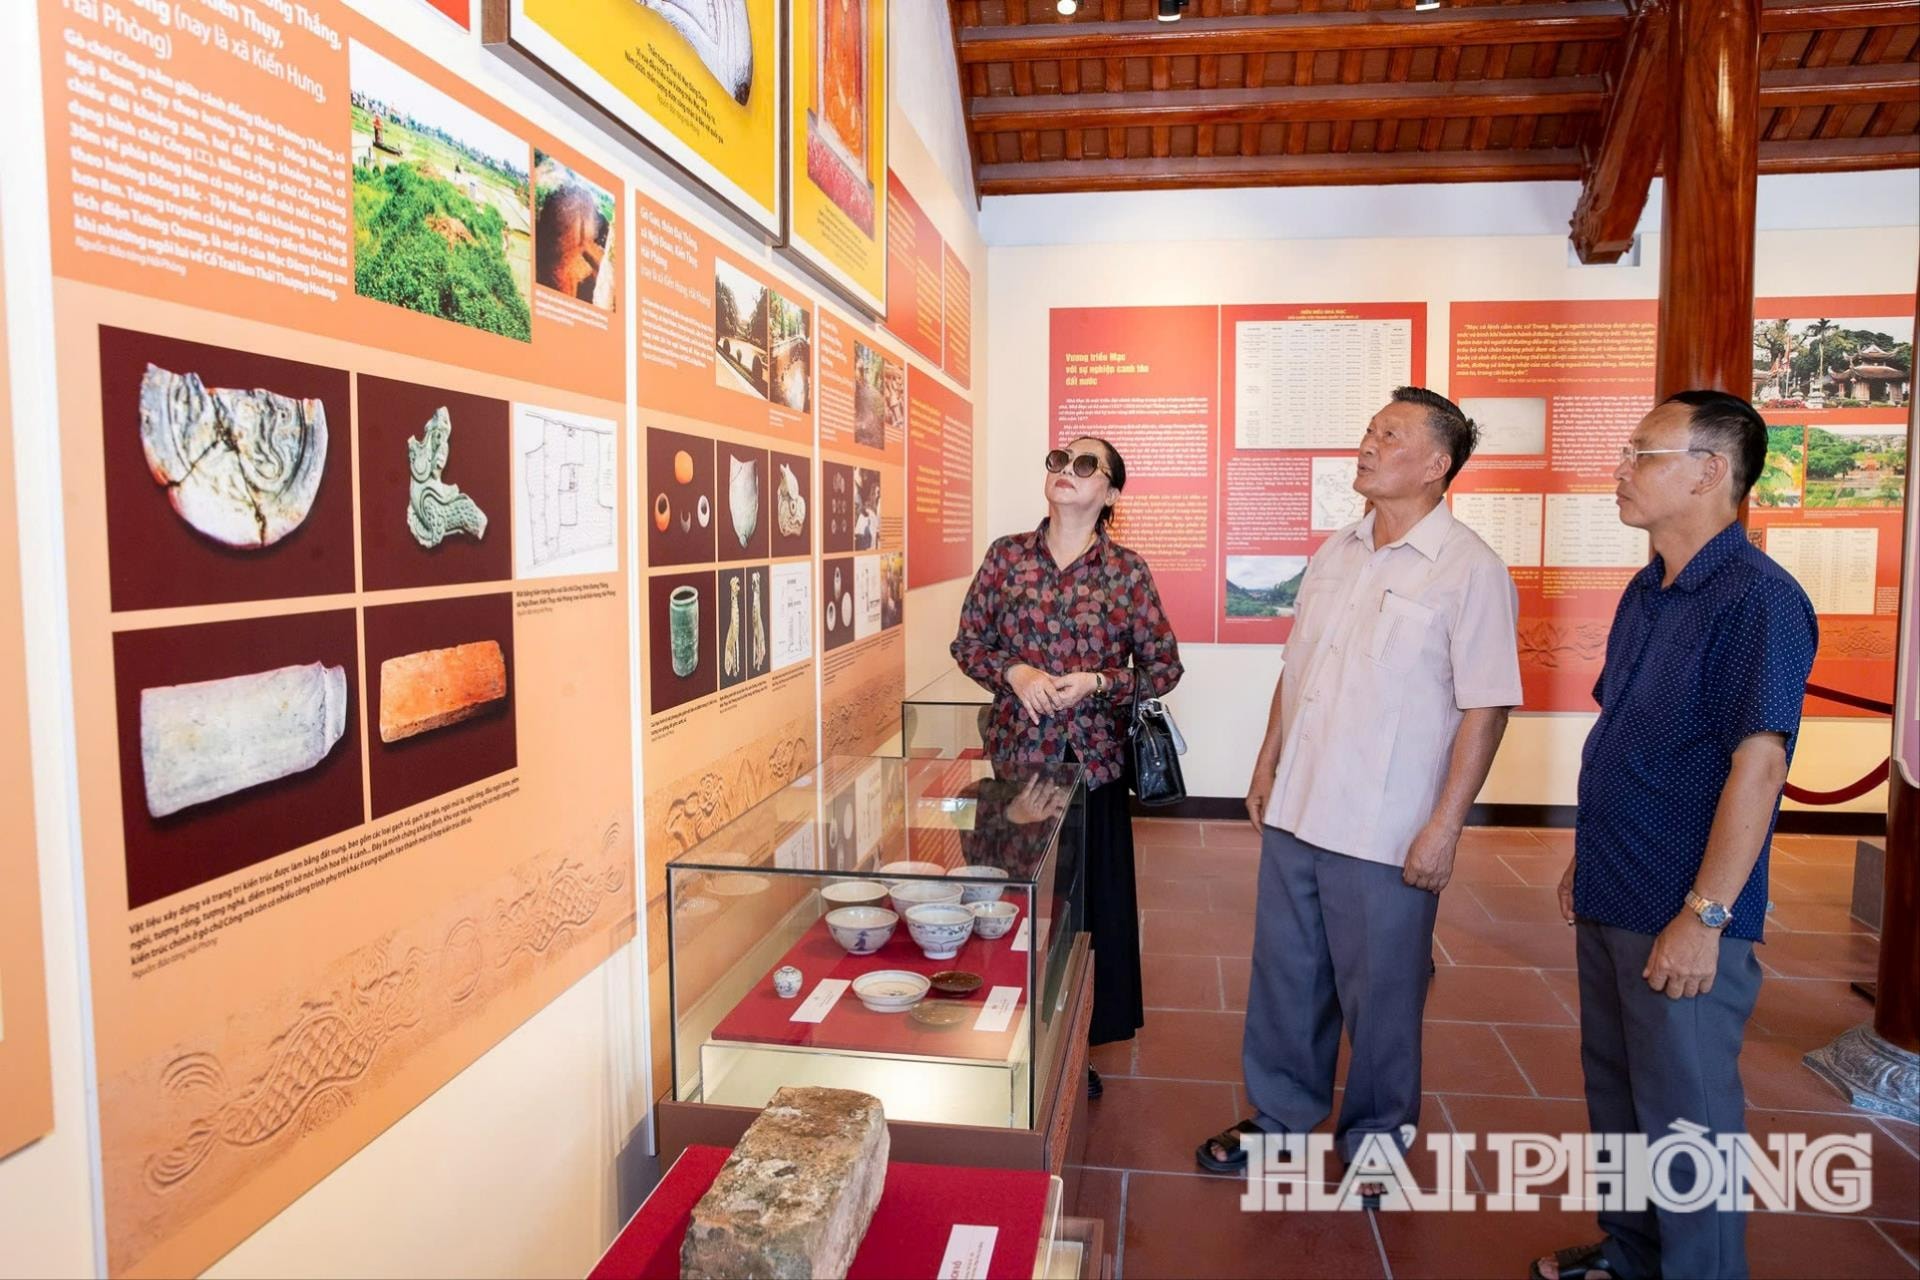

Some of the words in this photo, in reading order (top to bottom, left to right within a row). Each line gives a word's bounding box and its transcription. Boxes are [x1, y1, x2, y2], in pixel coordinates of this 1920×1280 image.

[103, 1, 172, 60] Phòng)
[240, 4, 284, 48] Thụy,
[294, 3, 341, 50] Thắng,
[174, 3, 211, 45] (nay
[214, 24, 228, 50] là
[231, 38, 249, 61] xã
[252, 45, 285, 79] Kiến
[286, 63, 327, 103] Hưng,
[1109, 352, 1126, 363] Mạc
